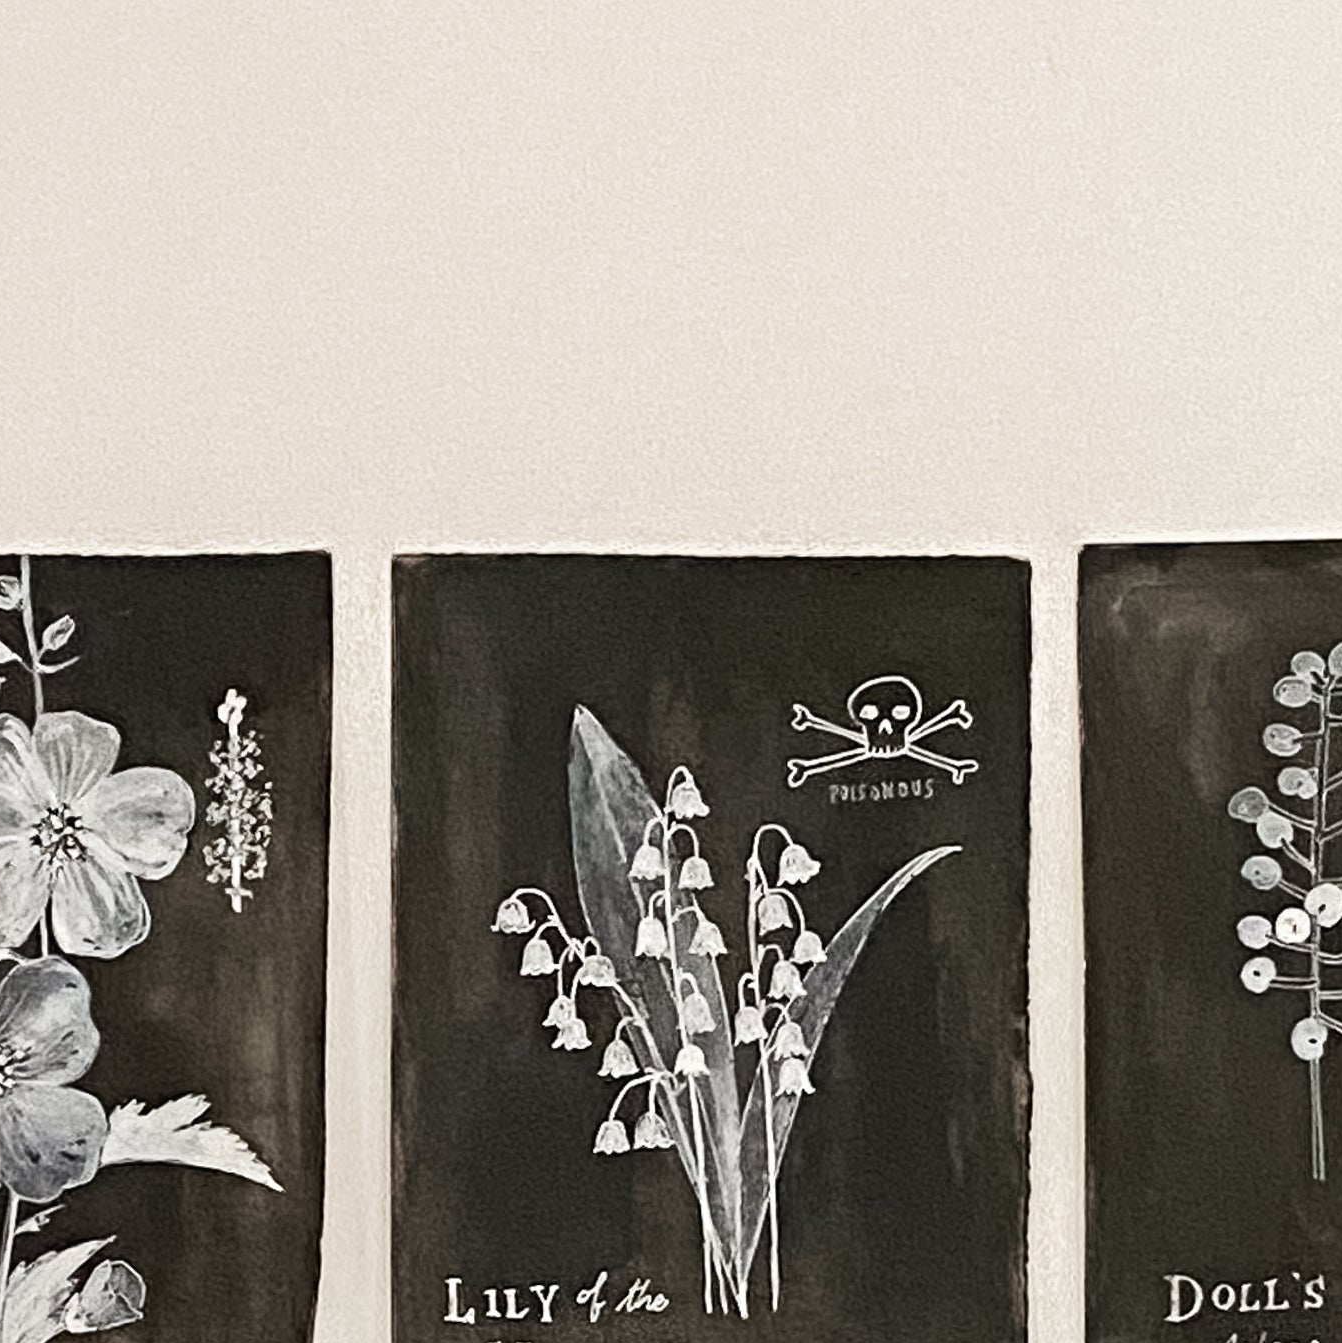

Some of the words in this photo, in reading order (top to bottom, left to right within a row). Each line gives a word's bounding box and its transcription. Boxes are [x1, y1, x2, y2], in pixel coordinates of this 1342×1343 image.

[829, 778, 934, 803] POISONOUS
[444, 1277, 559, 1324] LILY
[576, 1270, 608, 1323] of
[615, 1278, 670, 1312] the
[1163, 1272, 1326, 1322] DOLL'S
